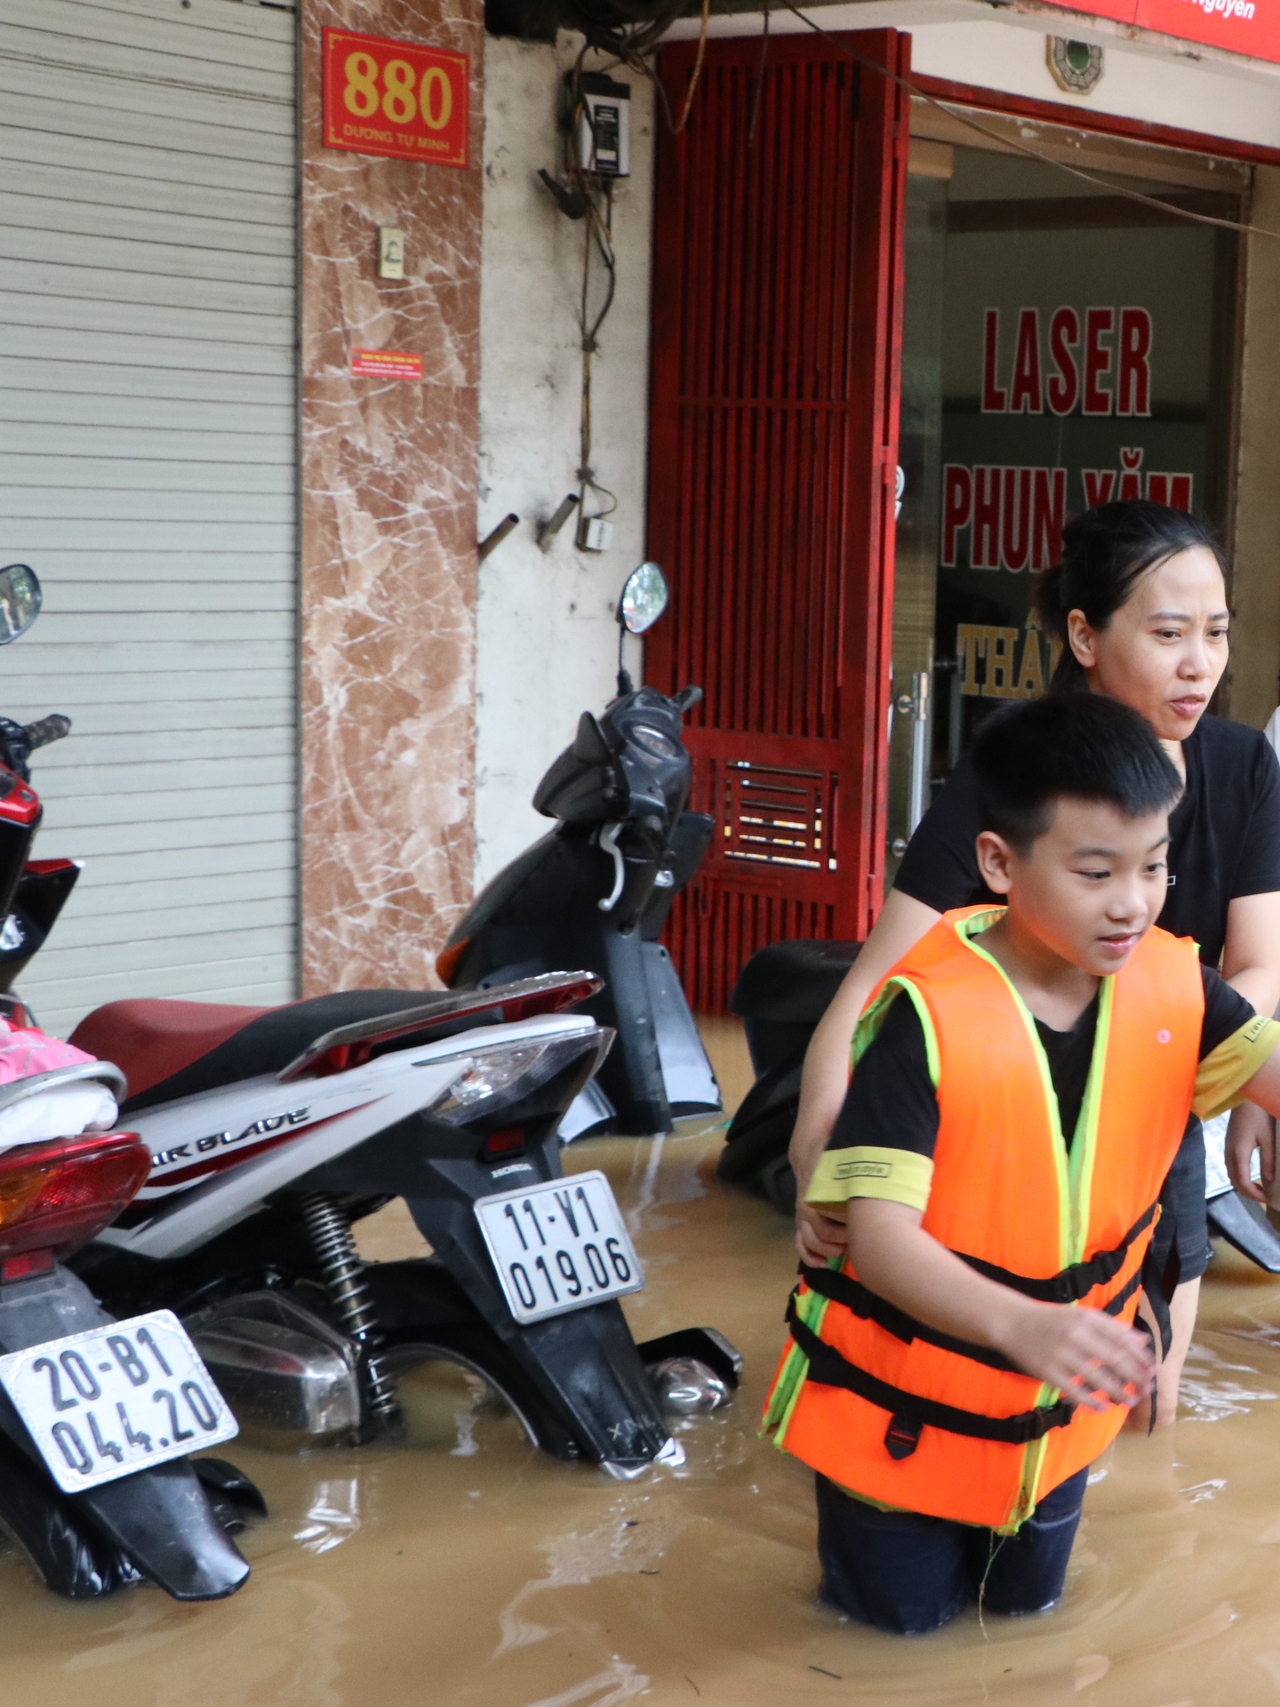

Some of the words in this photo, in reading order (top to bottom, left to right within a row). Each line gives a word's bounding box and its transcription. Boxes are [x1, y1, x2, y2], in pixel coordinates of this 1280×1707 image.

[343, 51, 453, 130] 880
[417, 137, 451, 152] MINH
[982, 306, 1153, 417] LASER
[940, 463, 1067, 573] PHUN
[150, 1143, 193, 1168] IR
[196, 1105, 311, 1152] BLADE
[510, 1237, 631, 1310] 019.06
[33, 1327, 173, 1412] 20-B1
[51, 1380, 218, 1475] 044.20
